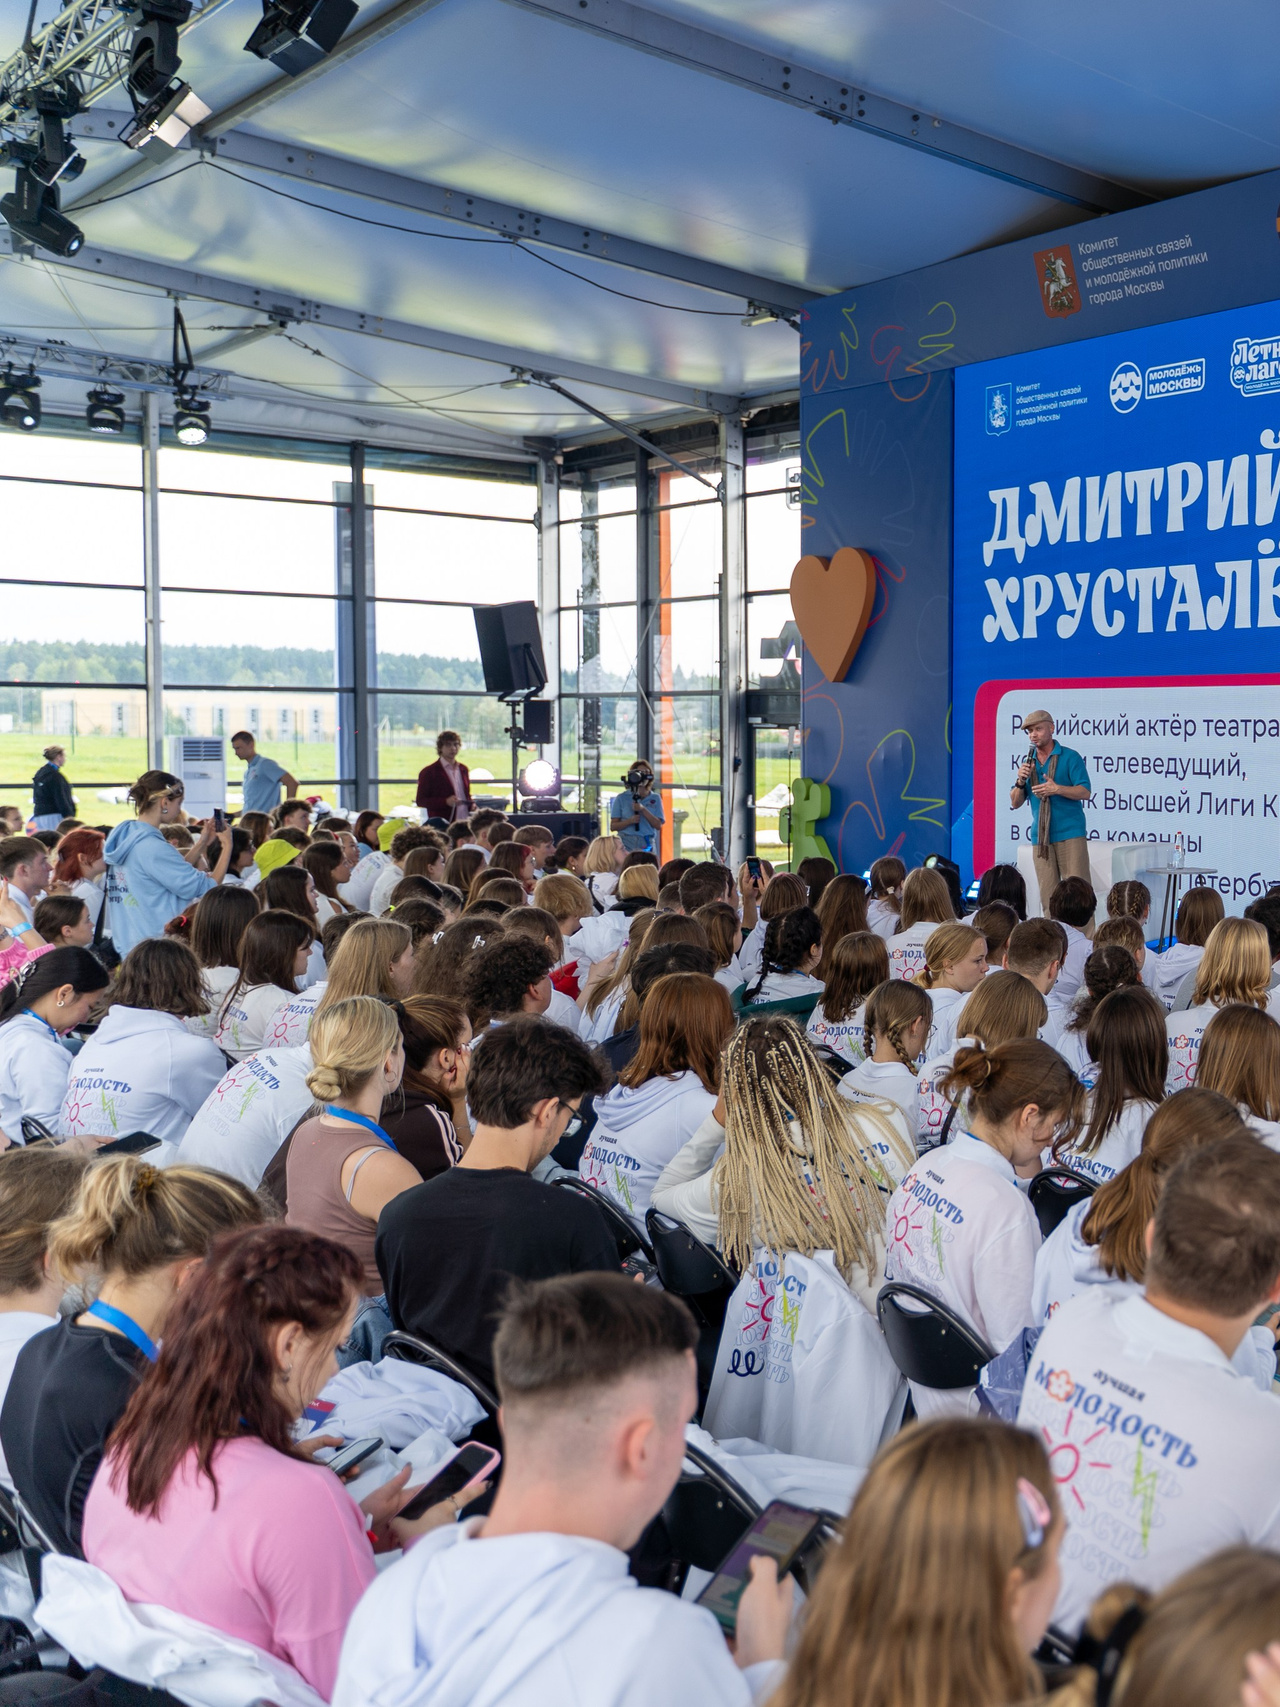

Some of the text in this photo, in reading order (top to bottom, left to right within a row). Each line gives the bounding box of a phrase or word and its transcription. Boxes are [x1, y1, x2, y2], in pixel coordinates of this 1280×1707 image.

[1078, 236, 1119, 255] Комитет
[1081, 235, 1193, 272] общественных связей
[1085, 252, 1209, 288] и молодёжной политики
[1089, 280, 1165, 305] города Москвы
[1149, 364, 1202, 381] МОЛОДЁЖЬ
[1016, 382, 1041, 393] Комитет
[1016, 385, 1082, 404] общественных связей
[1149, 375, 1201, 396] МОСКВЫ
[1058, 397, 1088, 408] политики
[1015, 414, 1061, 427] города Москвы
[1011, 713, 1129, 736] Рийский
[1135, 714, 1197, 742] актёр
[1203, 718, 1280, 743] театра
[1093, 752, 1247, 781] телеведущий,
[1104, 788, 1190, 814] Высшей
[1196, 791, 1254, 817] Лиги
[1010, 825, 1020, 841] в
[1093, 1368, 1147, 1403] лучшая
